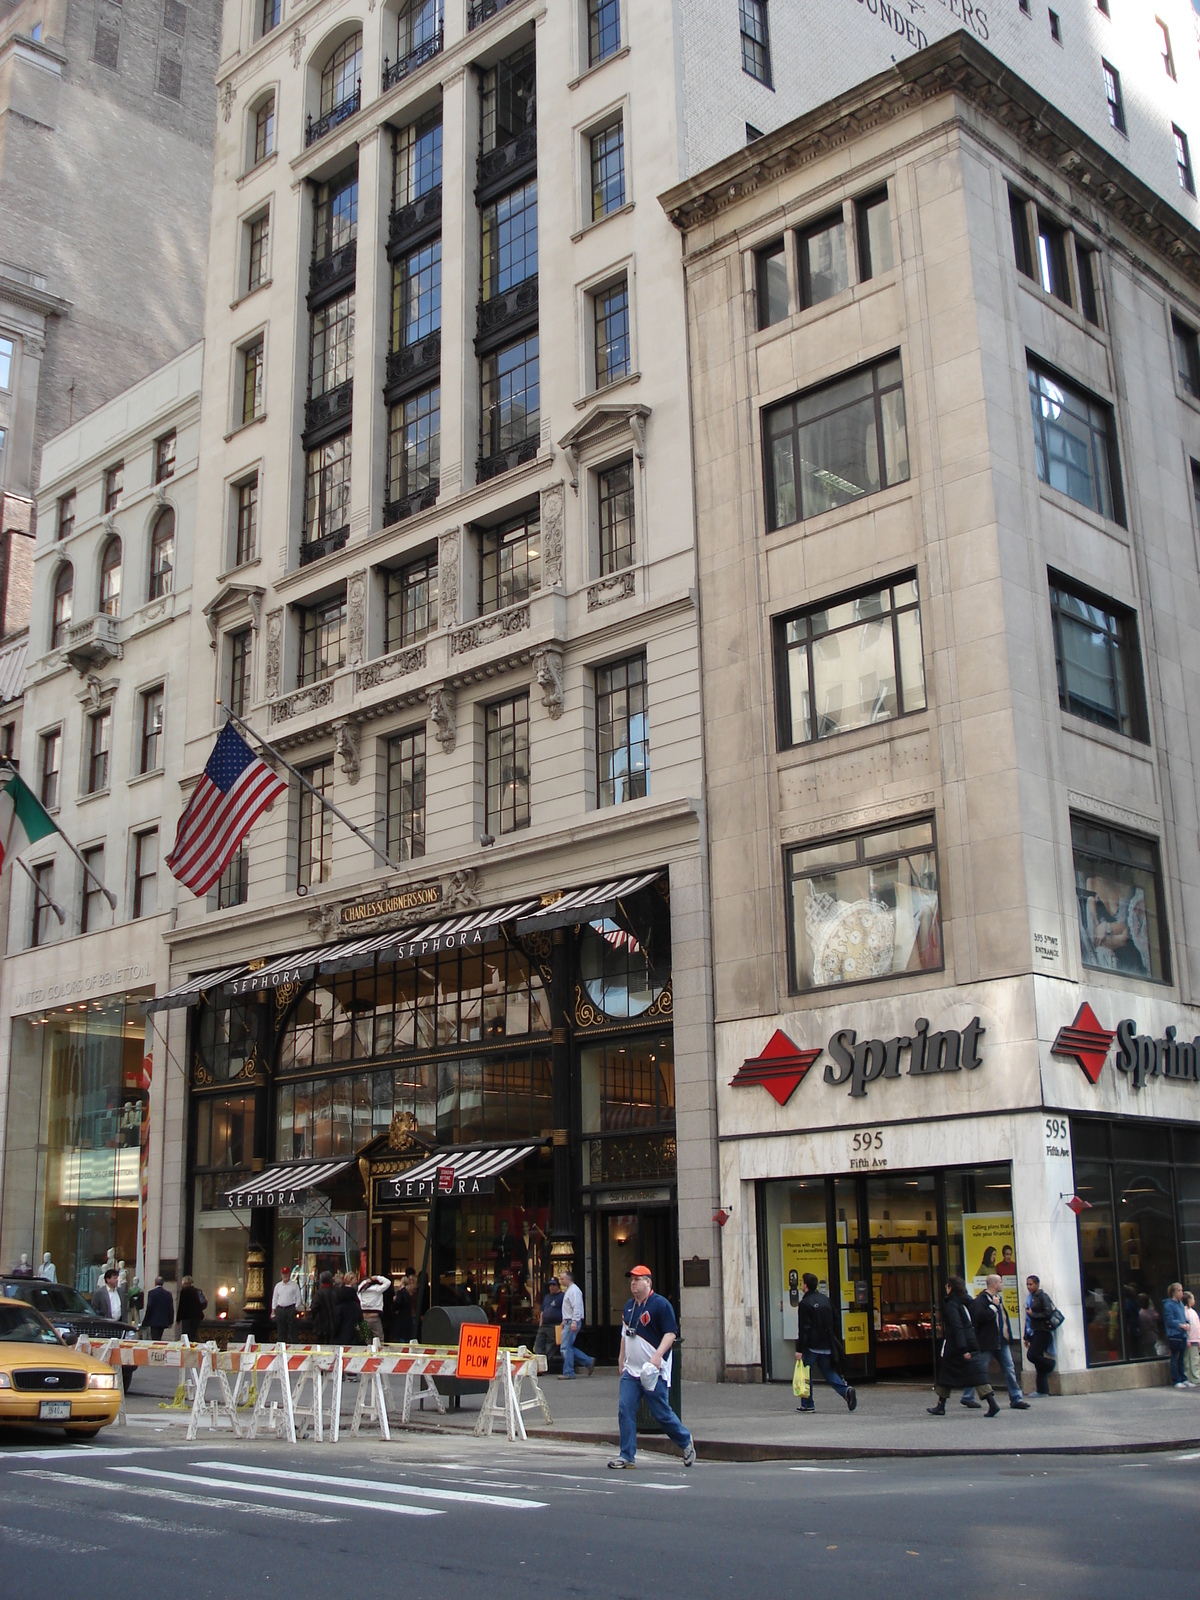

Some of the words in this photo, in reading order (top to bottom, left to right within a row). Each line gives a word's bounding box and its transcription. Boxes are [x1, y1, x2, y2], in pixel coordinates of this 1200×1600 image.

[857, 0, 929, 50] UNDED
[344, 902, 376, 922] CHARLES
[417, 888, 438, 905] SONS
[398, 930, 482, 959] SEPHORA
[15, 988, 45, 1008] UNITED
[47, 979, 82, 1000] COLORS
[85, 975, 97, 991] OF
[232, 969, 301, 995] SEPHORA
[823, 1016, 986, 1097] Sprint
[1045, 1119, 1067, 1139] 595
[852, 1131, 883, 1151] 595
[850, 1158, 870, 1169] Fifth
[872, 1157, 888, 1167] Ave
[228, 1192, 296, 1207] SEPHORA
[466, 1334, 493, 1349] RAISE
[465, 1354, 490, 1368] PLOW
